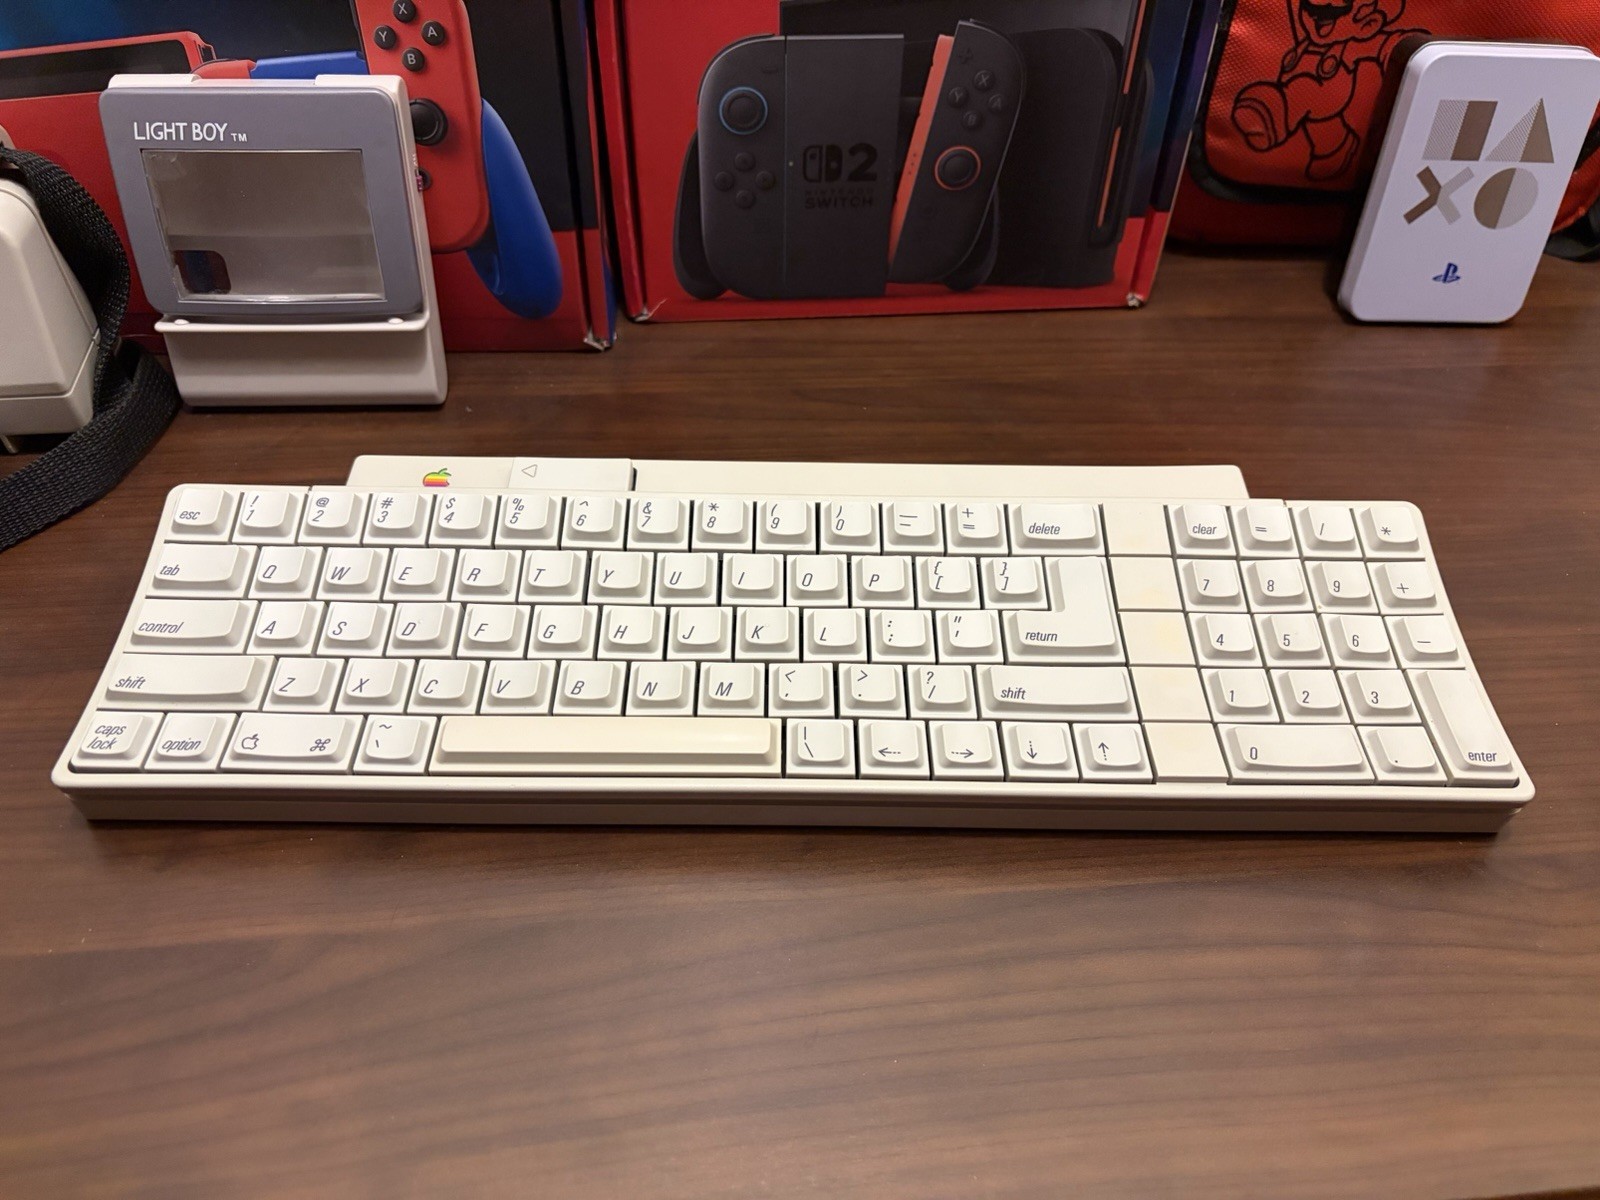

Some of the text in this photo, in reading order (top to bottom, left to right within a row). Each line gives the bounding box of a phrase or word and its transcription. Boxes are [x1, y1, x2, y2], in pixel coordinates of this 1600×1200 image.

[397, 2, 408, 15] X
[378, 30, 388, 42] Y
[427, 26, 438, 38] A
[407, 53, 416, 65] B
[133, 121, 248, 142] LIGHT BOY TM
[846, 142, 878, 182] 2
[804, 196, 874, 210] SWITCH
[250, 496, 259, 507] !
[316, 497, 329, 507] @
[381, 498, 393, 509] #
[446, 498, 456, 509] $
[513, 498, 524, 511] %
[643, 502, 652, 514] &
[179, 511, 200, 520] esc
[312, 510, 324, 522] 2
[377, 511, 388, 522] 3
[444, 512, 454, 523] 4
[510, 512, 521, 524] 5
[576, 514, 586, 526] 6
[642, 516, 651, 527] 7
[707, 516, 716, 528] 8
[771, 517, 780, 529] 9
[1029, 523, 1060, 534] delete
[1193, 524, 1217, 534] clear
[160, 565, 180, 575] tab
[263, 565, 277, 579] Q
[331, 567, 351, 580] W
[398, 567, 412, 580] E
[467, 568, 481, 581] R
[534, 569, 546, 582] T
[603, 570, 614, 583] Y
[670, 572, 682, 585] U
[869, 574, 879, 587] P
[1203, 579, 1209, 591] 7
[1267, 580, 1274, 592] 8
[1334, 580, 1340, 592] 9
[139, 622, 184, 633] control
[261, 621, 276, 634] A
[332, 622, 347, 635] S
[401, 622, 416, 636] D
[474, 623, 488, 636] F
[543, 625, 556, 638] G
[614, 625, 628, 639] H
[682, 626, 695, 639] J
[751, 626, 764, 639] K
[820, 627, 826, 641] L
[1025, 632, 1057, 641] return
[1216, 634, 1224, 646] 4
[1283, 634, 1290, 646] 5
[1352, 635, 1359, 647] 6
[115, 676, 145, 689] shift
[927, 671, 934, 684] ?
[279, 678, 296, 692] Z
[352, 678, 370, 693] X
[424, 680, 438, 694] C
[497, 680, 511, 693] V
[571, 681, 585, 695] B
[642, 682, 658, 696] N
[715, 682, 733, 696] M
[1001, 687, 1026, 700] shift
[1302, 691, 1309, 703] 2
[1371, 691, 1378, 704] 3
[95, 725, 126, 737] caps
[87, 737, 117, 749] lock
[162, 738, 201, 752] option
[1467, 751, 1498, 763] enter
